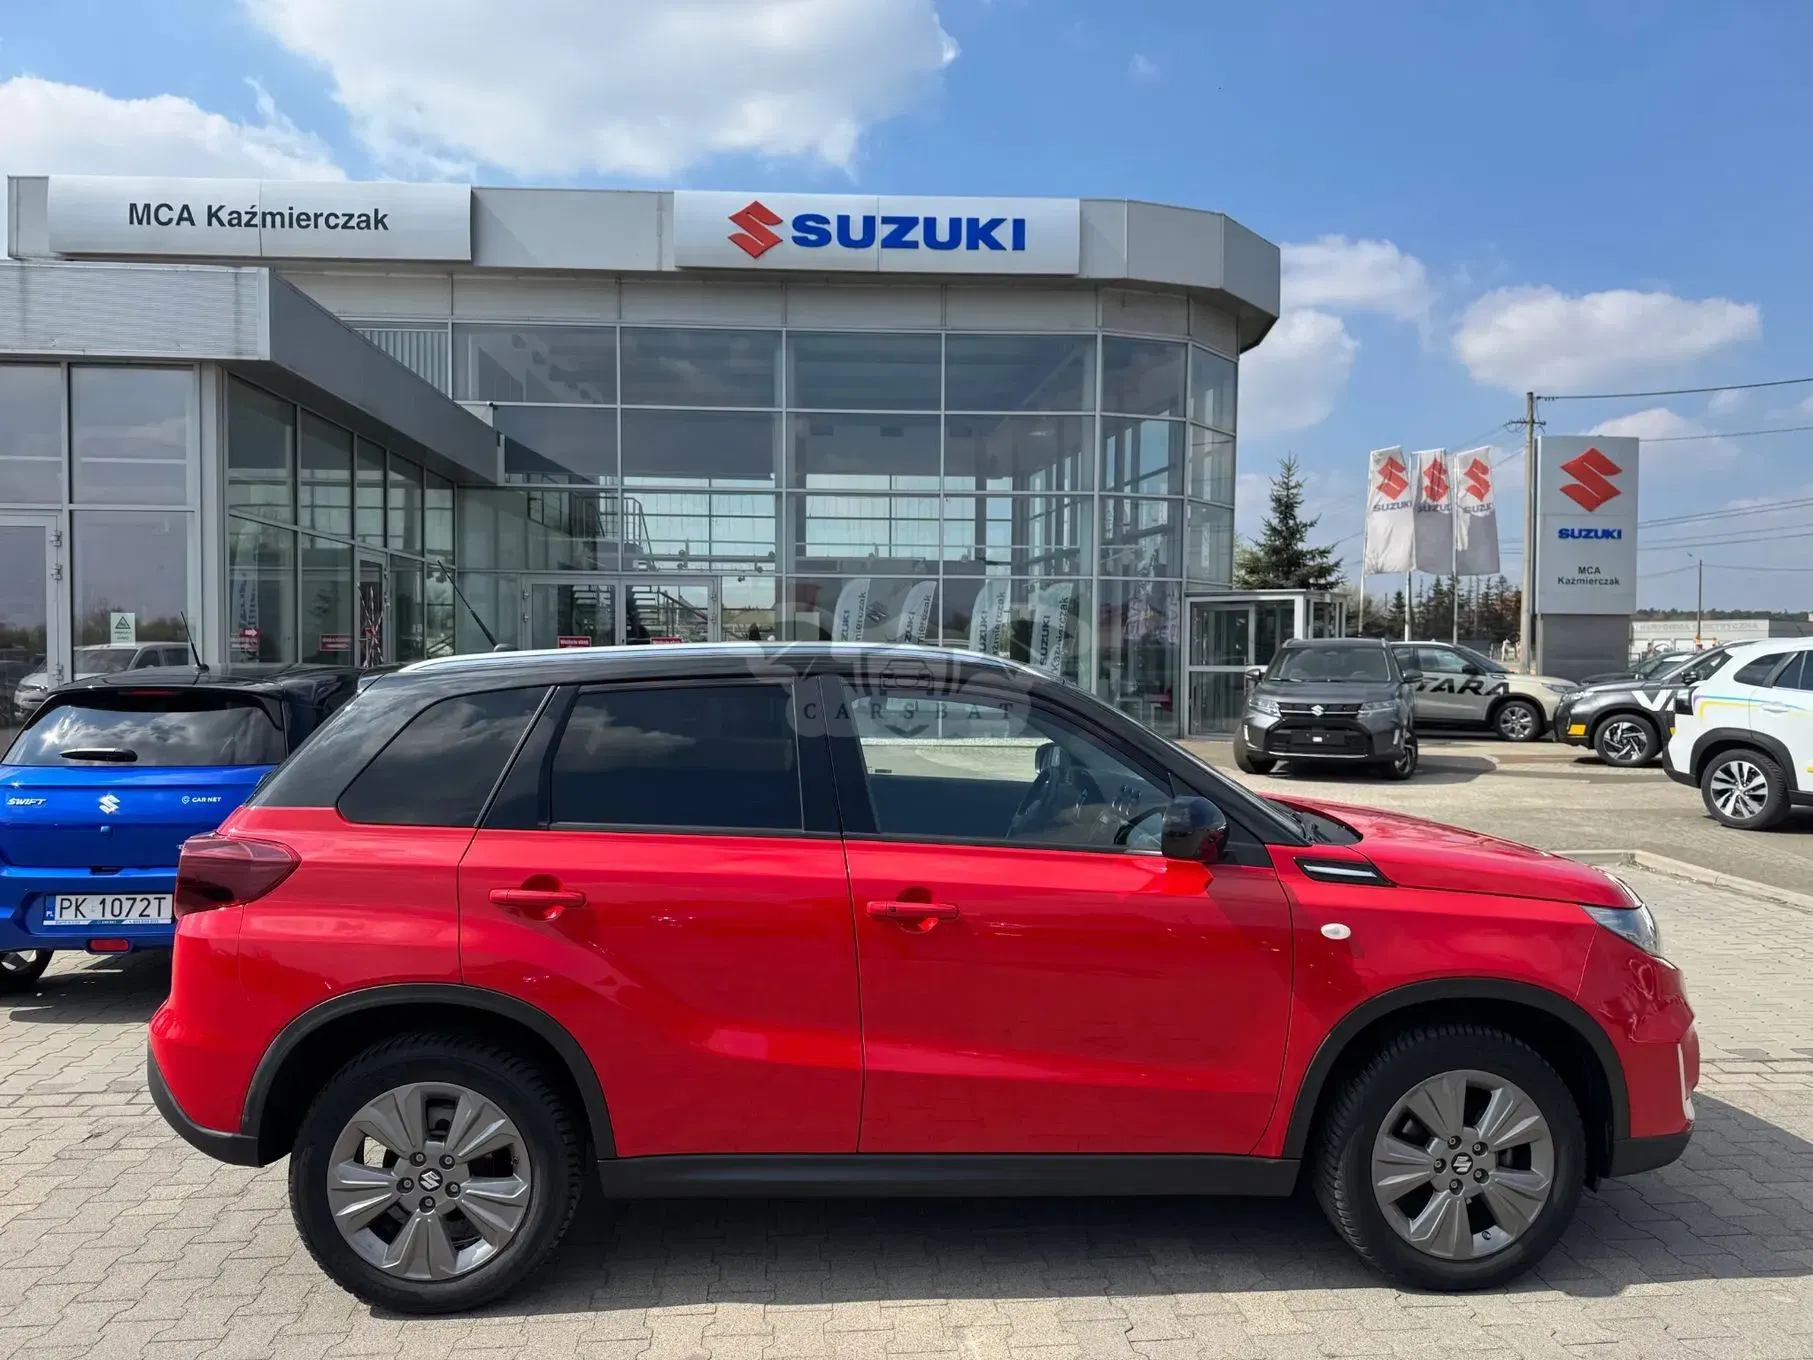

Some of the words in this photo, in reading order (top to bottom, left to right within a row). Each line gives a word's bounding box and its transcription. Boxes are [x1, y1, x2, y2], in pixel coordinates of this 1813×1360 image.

[128, 202, 197, 227] MCA
[206, 204, 389, 231] Kaźmierczak
[791, 213, 1026, 251] SUZUKI
[1557, 528, 1622, 540] SUZUKI
[1578, 566, 1601, 575] MCA
[979, 610, 988, 652] UZUKI
[1040, 615, 1050, 666] SUZUKI
[7, 798, 47, 806] SWIFT
[59, 897, 88, 918] PK
[99, 897, 167, 918] 1072T
